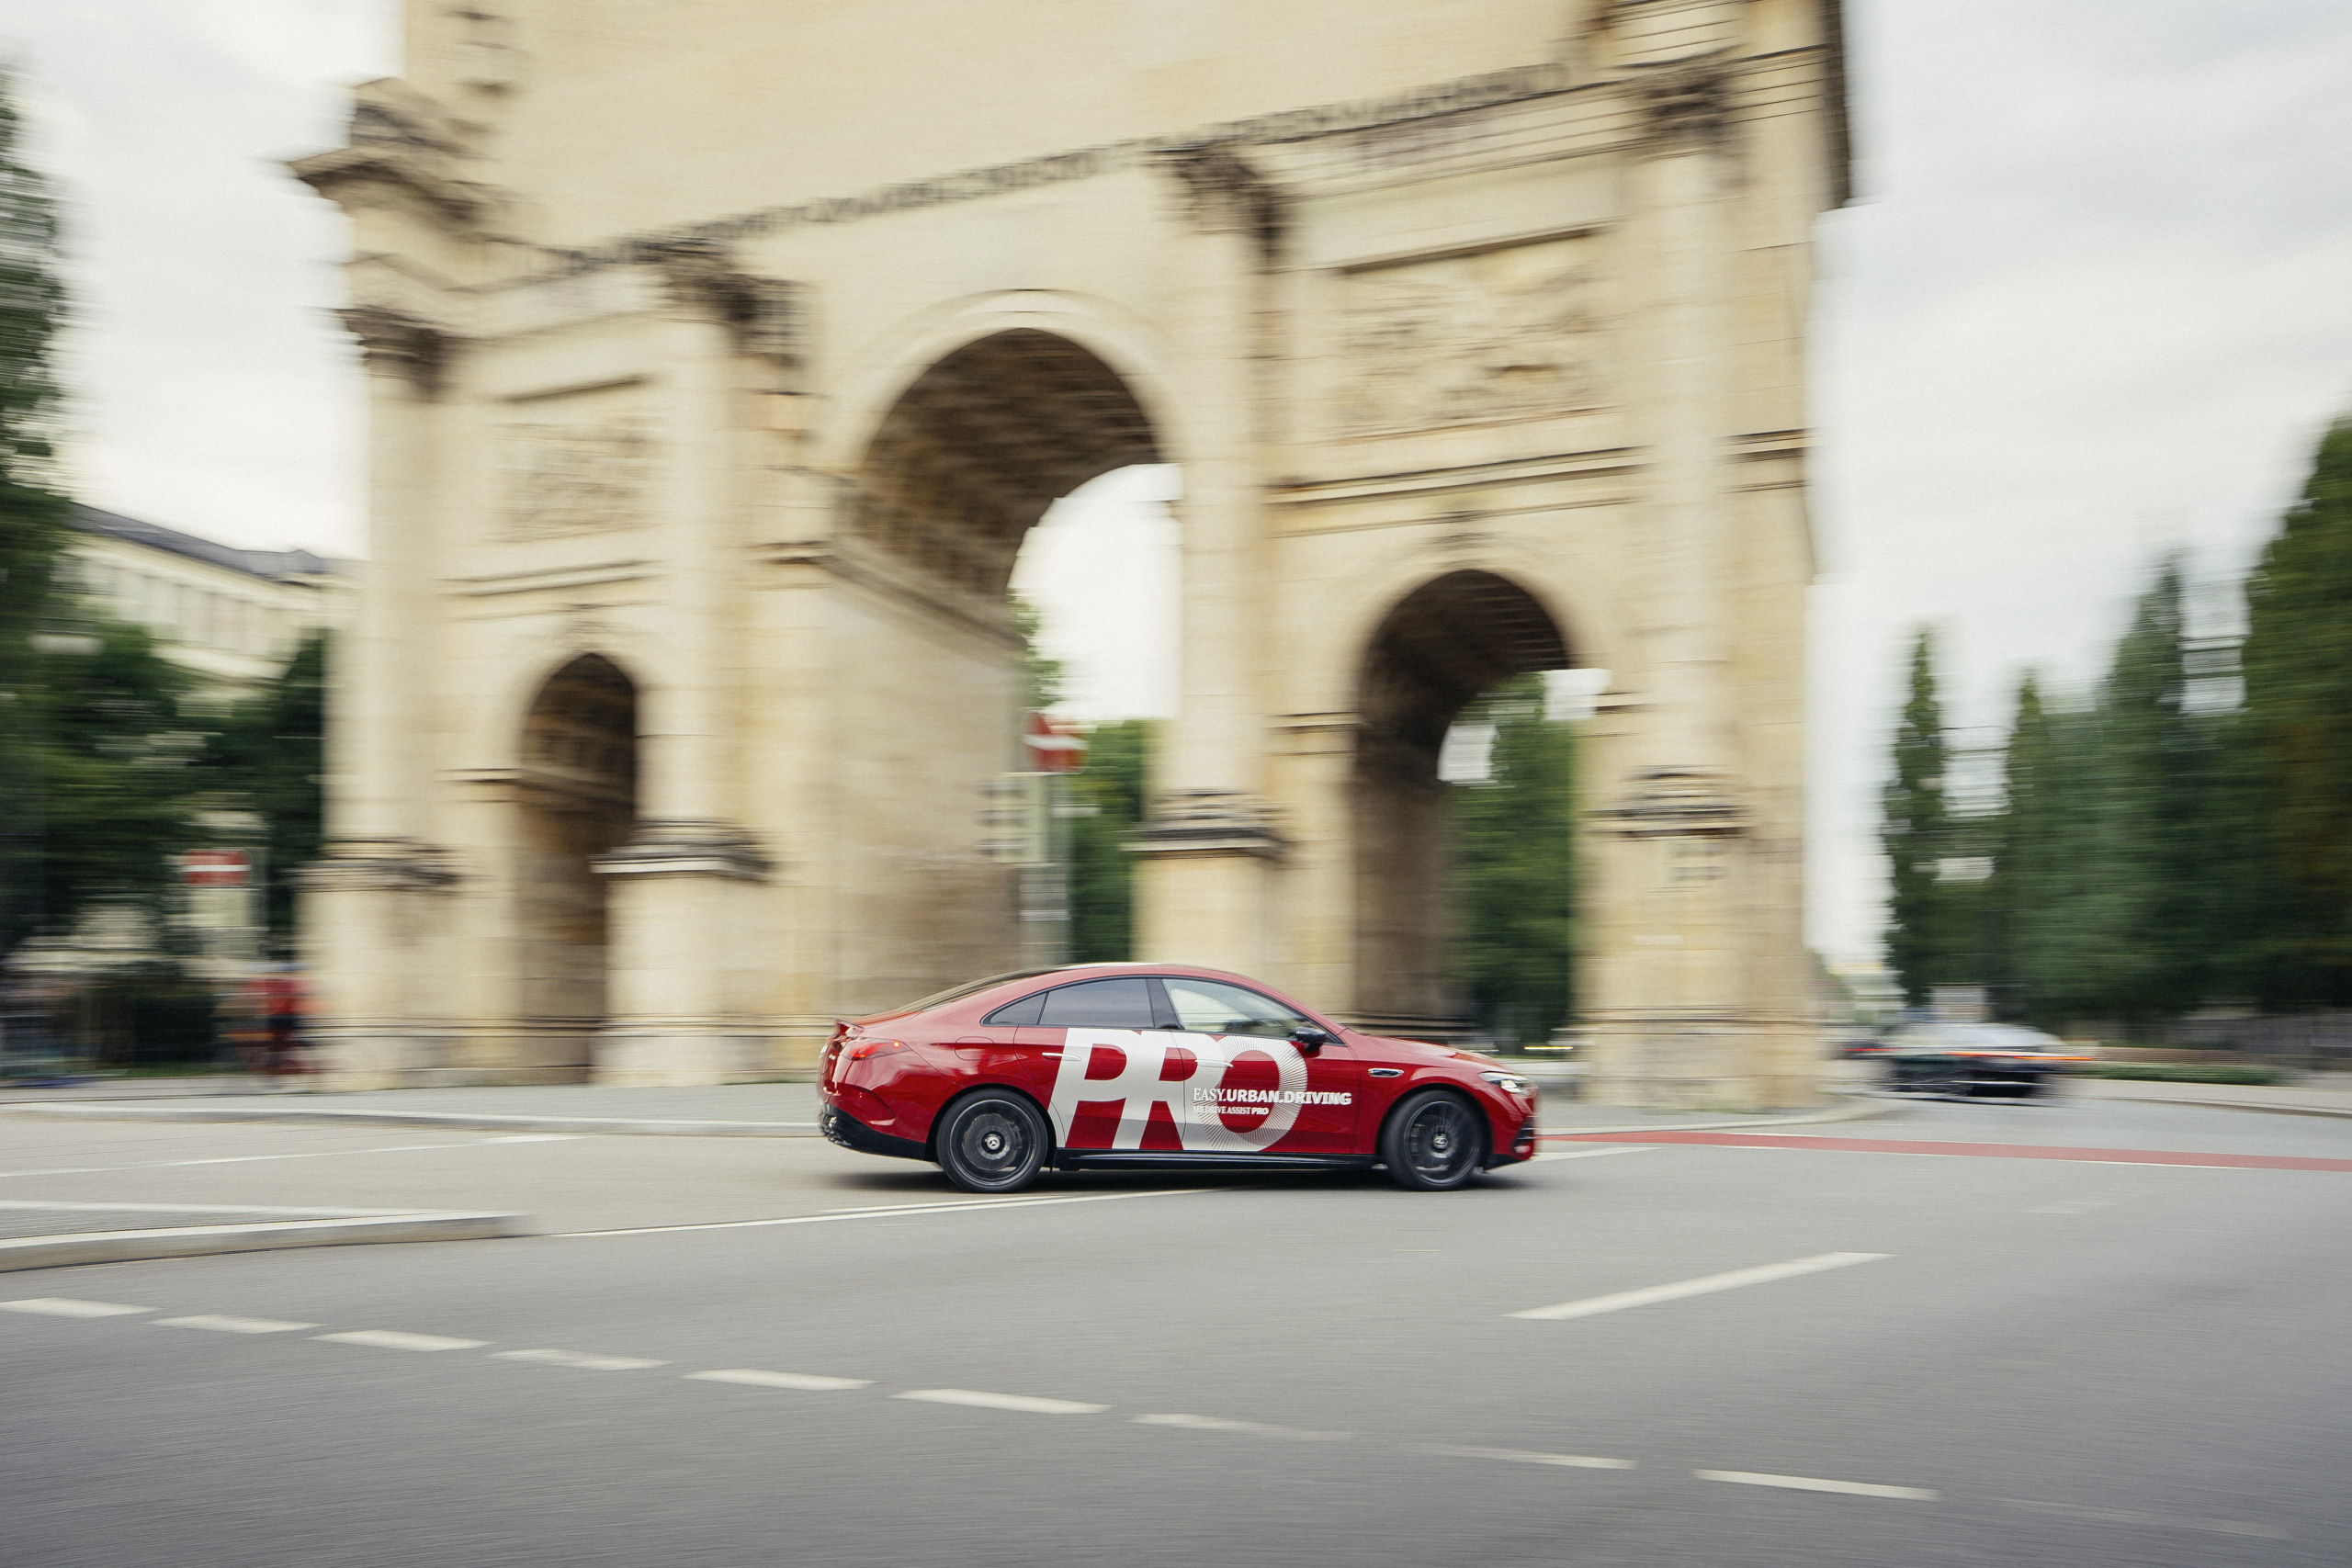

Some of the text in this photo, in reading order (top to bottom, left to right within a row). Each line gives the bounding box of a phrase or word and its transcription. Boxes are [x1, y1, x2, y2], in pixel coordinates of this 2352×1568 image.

[1047, 1027, 1307, 1152] PRO
[1193, 1088, 1352, 1105] EASY.URBAN.DRIVING
[1227, 1106, 1251, 1115] ASSIST
[1251, 1107, 1270, 1115] PRO
